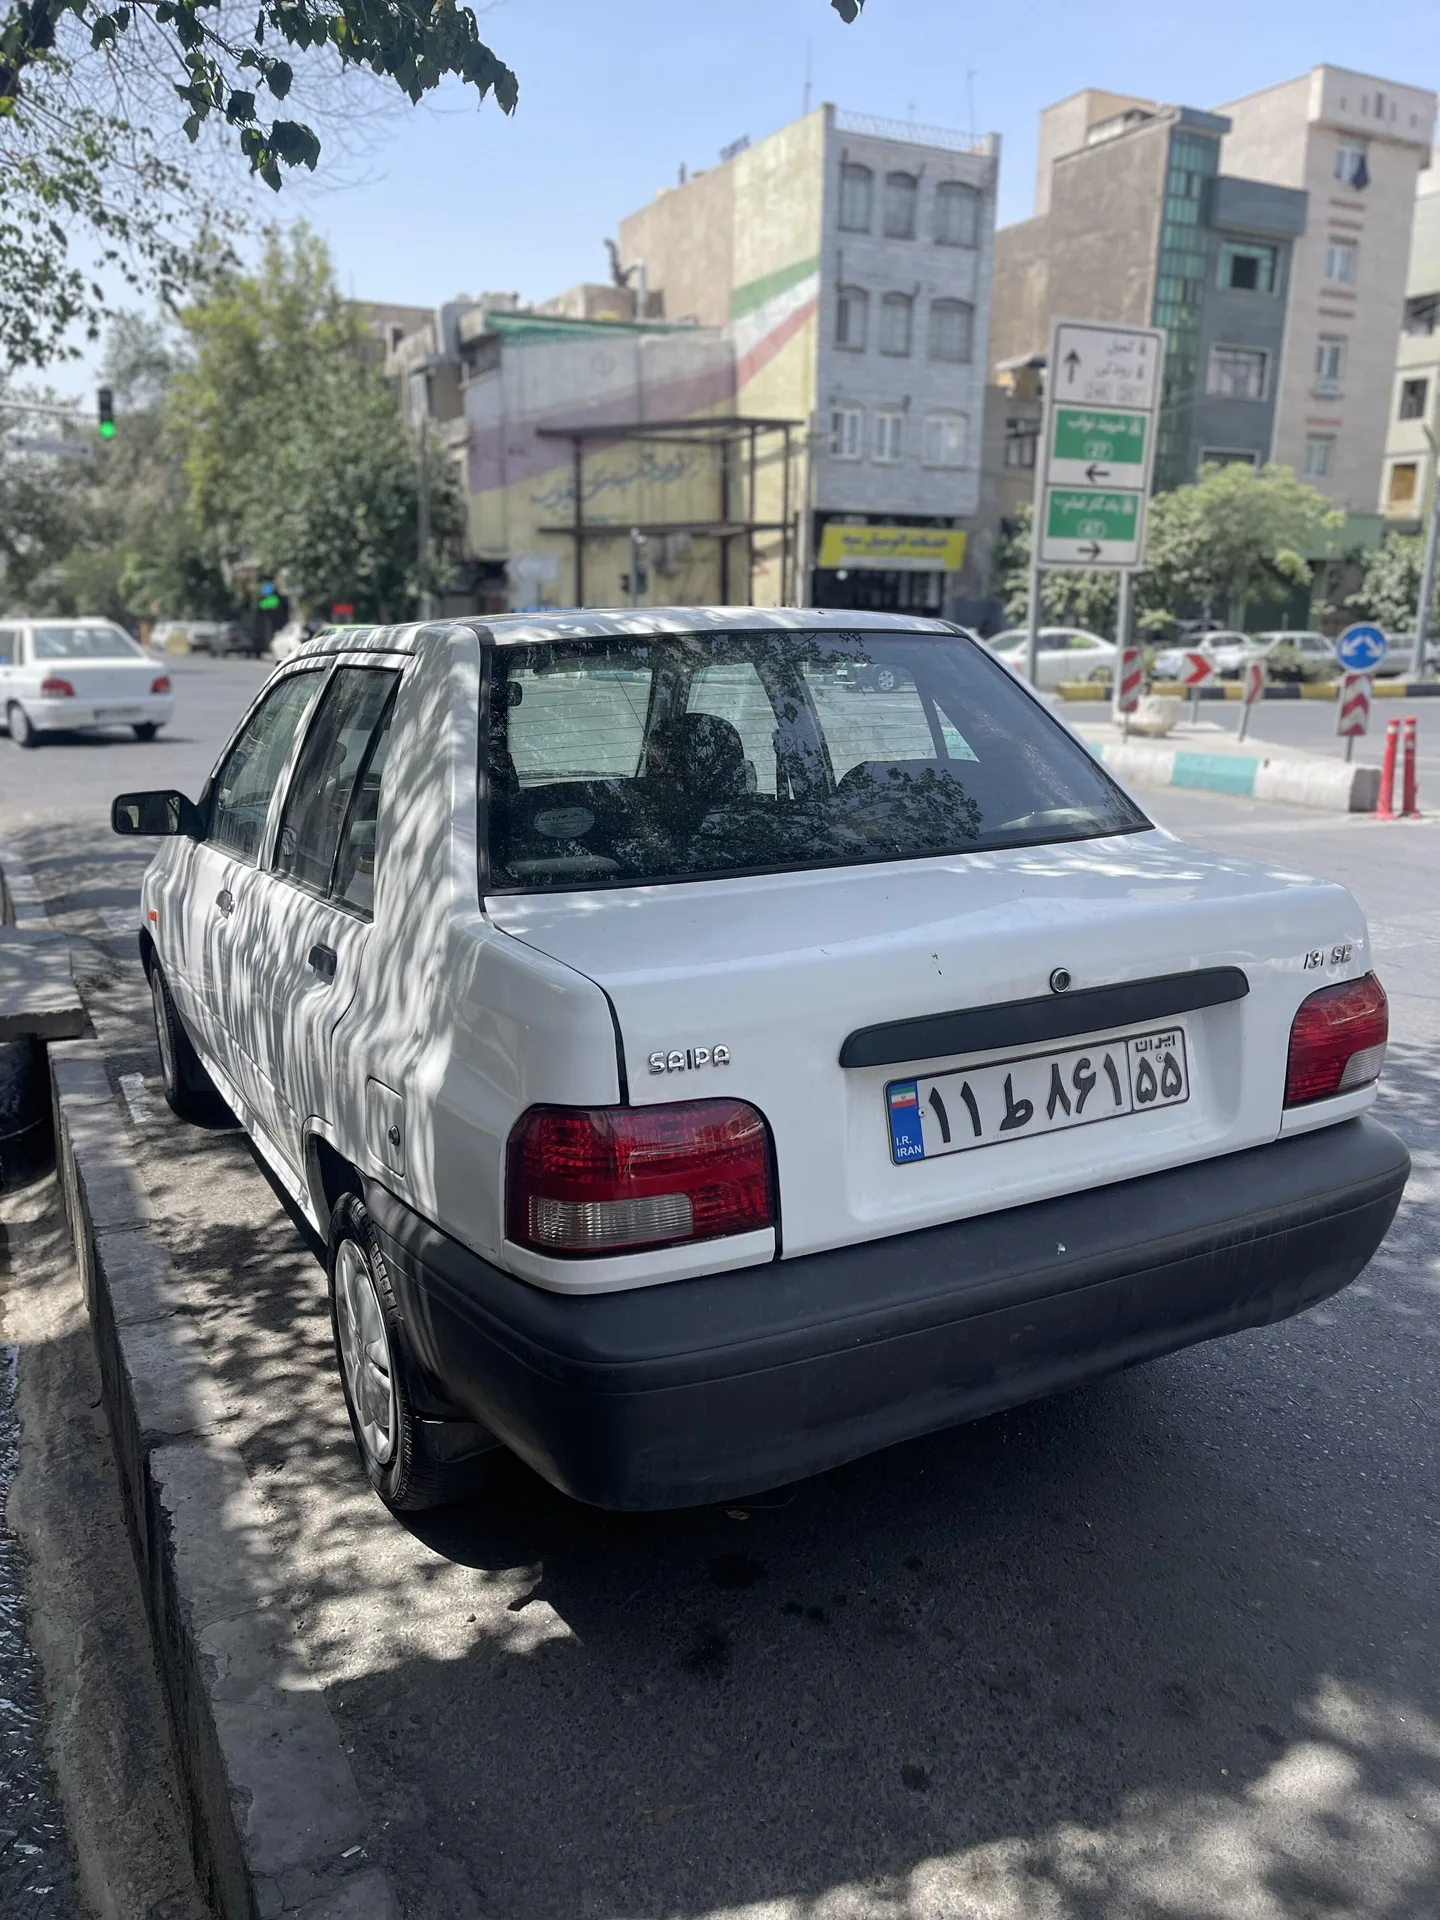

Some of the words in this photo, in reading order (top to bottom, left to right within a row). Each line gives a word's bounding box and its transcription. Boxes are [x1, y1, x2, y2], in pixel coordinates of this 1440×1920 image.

[1303, 949, 1325, 970] 131
[1331, 944, 1353, 965] SE
[1135, 1034, 1176, 1053] ایران
[648, 1043, 731, 1076] SAIPA
[895, 1135, 913, 1147] I.R.
[897, 1144, 922, 1158] IRAN
